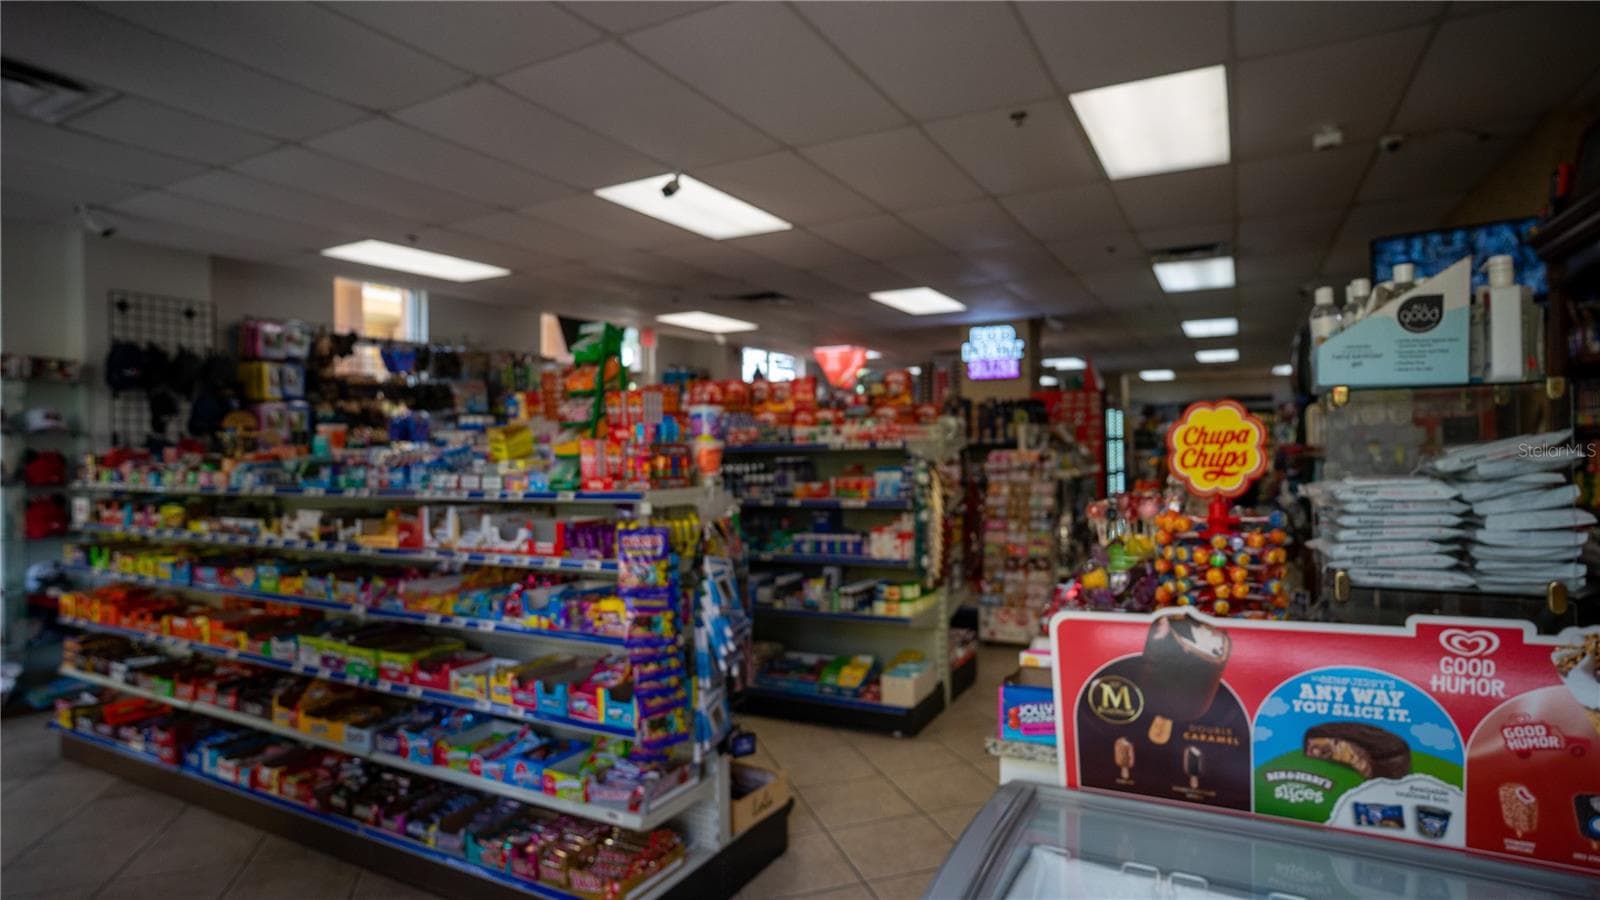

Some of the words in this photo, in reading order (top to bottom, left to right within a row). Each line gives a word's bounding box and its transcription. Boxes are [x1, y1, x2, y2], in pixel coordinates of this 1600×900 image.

[1183, 425, 1251, 449] Chupa
[1180, 448, 1248, 481] Chups
[1440, 656, 1496, 677] GOOD
[1100, 683, 1132, 710] M
[1299, 683, 1347, 702] ANY
[1351, 687, 1405, 707] WAY
[1431, 673, 1505, 698] HUMOR
[1292, 699, 1329, 715] YOU
[1332, 703, 1384, 720] SLICE
[1388, 708, 1411, 722] IT.
[1183, 731, 1239, 747] CARAMEL
[1503, 725, 1547, 738] GOOD
[1507, 736, 1560, 751] HUMOR
